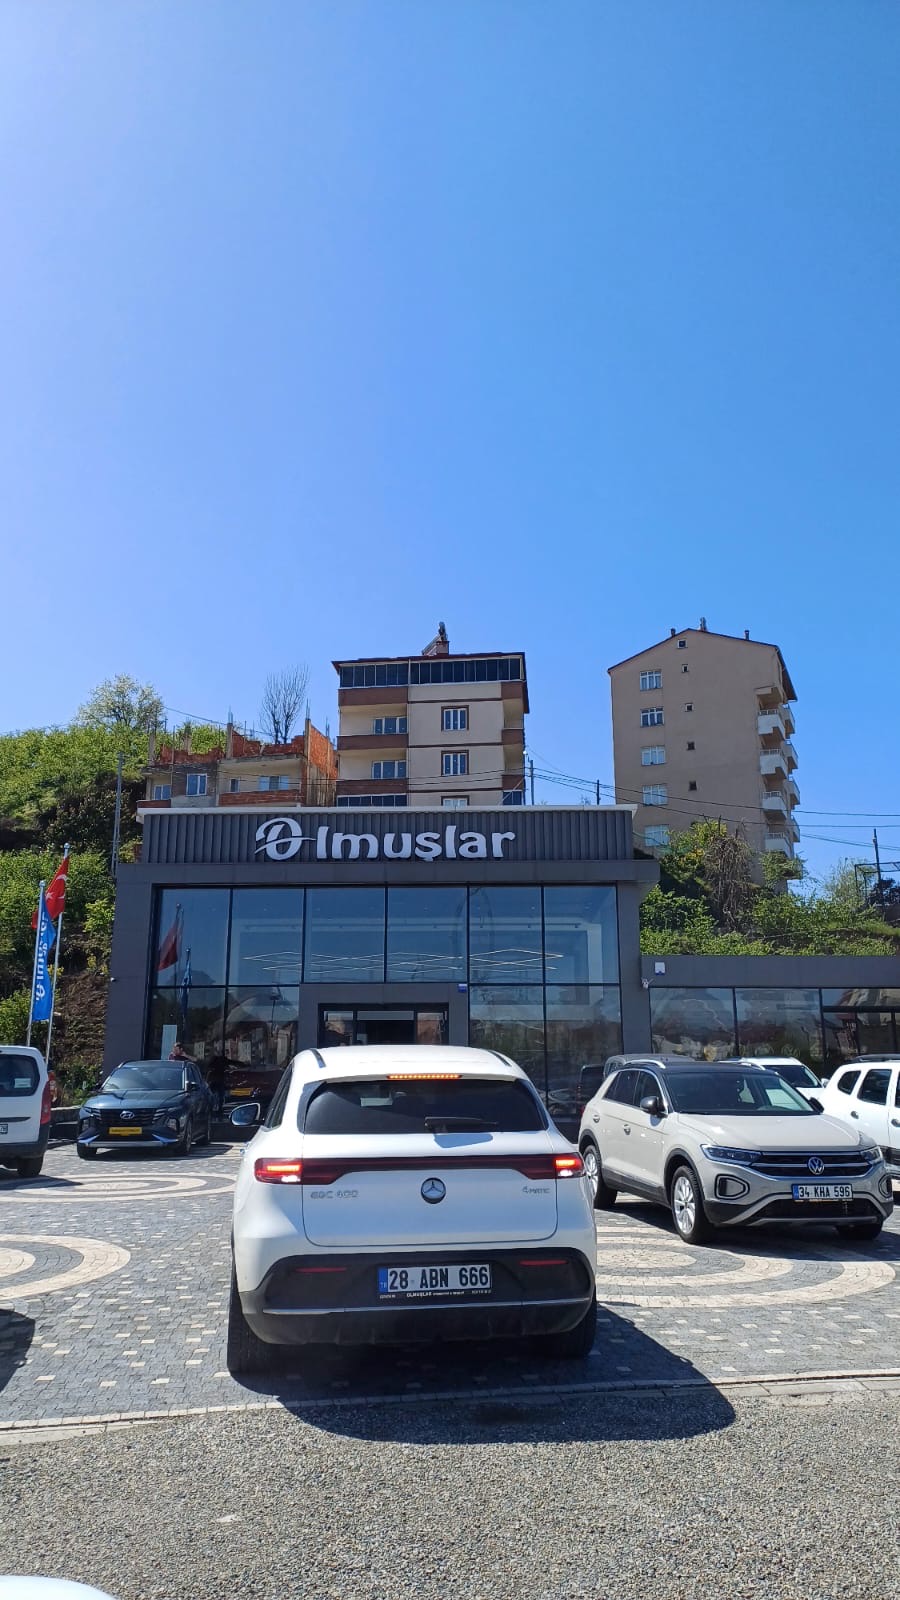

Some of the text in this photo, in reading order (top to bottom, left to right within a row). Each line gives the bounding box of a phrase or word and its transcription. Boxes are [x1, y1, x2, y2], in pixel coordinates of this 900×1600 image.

[799, 1186, 850, 1197] 34 KHA 596
[389, 1269, 408, 1290] 28
[419, 1268, 448, 1289] ABN
[459, 1266, 488, 1287] 666
